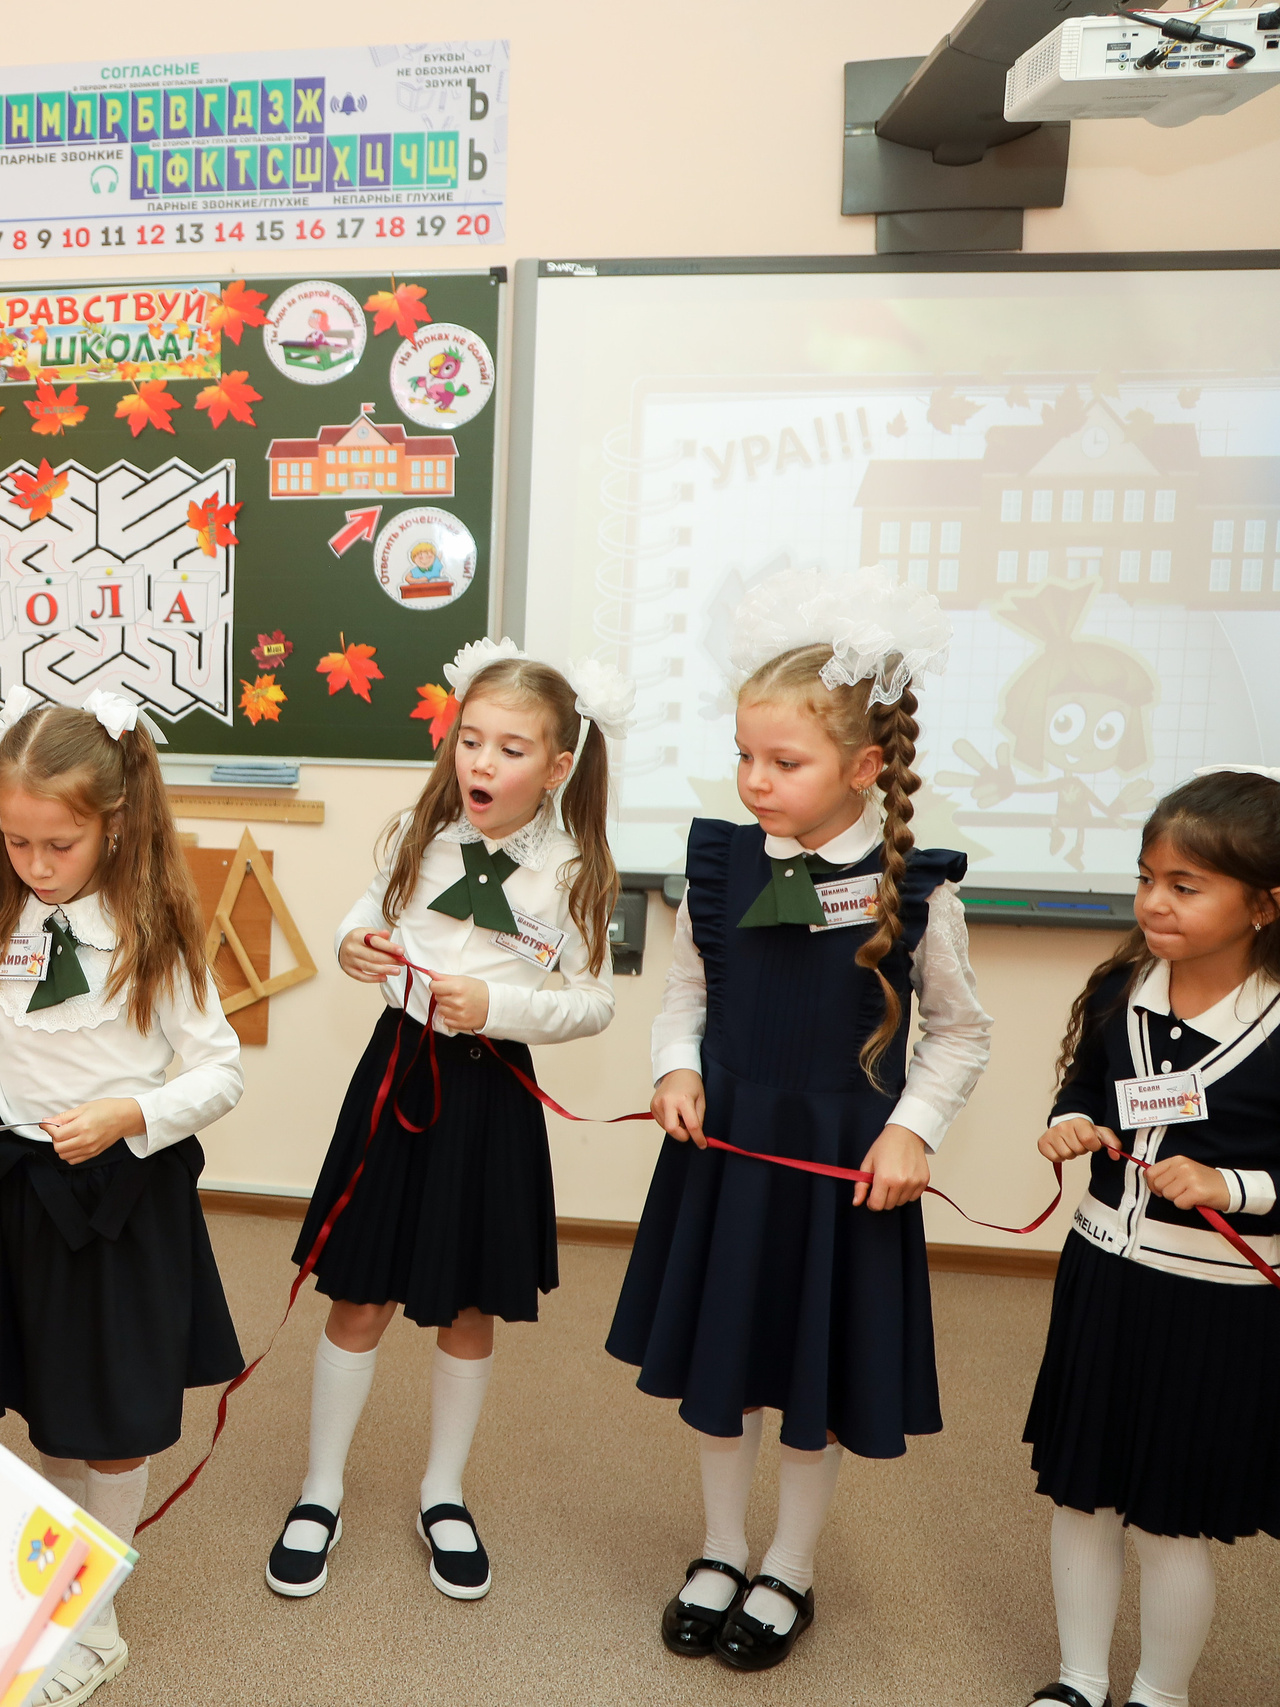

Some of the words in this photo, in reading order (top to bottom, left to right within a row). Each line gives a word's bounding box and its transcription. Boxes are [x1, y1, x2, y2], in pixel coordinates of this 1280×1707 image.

[424, 53, 465, 63] БУКВЫ
[101, 62, 200, 80] СОГЛАСНЫЕ
[397, 67, 411, 77] НЕ
[415, 64, 492, 76] ОБОЗНАЧАЮТ
[425, 79, 462, 88] ЗВУКИ
[61, 149, 124, 163] ЗВОНКИЕ
[468, 138, 488, 181] Ь
[147, 199, 198, 212] ПАРНЫЕ
[202, 196, 310, 211] ЗВОНКИЕ/ГЛУХИЕ
[333, 192, 403, 205] НЕПАРНЫЕ
[406, 191, 454, 203] ГЛУХИЕ
[12, 230, 28, 250] 8
[37, 228, 52, 249] 9
[62, 227, 90, 248] 10
[101, 226, 126, 247] 11
[137, 224, 165, 245] 12
[175, 223, 204, 244] 13
[214, 222, 244, 242] 14
[256, 220, 285, 241] 15
[295, 219, 326, 240] 16
[336, 218, 365, 238] 17
[375, 216, 405, 237] 18
[416, 215, 446, 236] 19
[456, 214, 491, 235] 20
[39, 330, 197, 368] ШКОЛА!
[399, 351, 412, 366] На
[453, 334, 467, 346] не
[467, 342, 490, 386] болтай!
[702, 406, 873, 486] УРА!!!
[380, 531, 400, 585] Ответить
[821, 887, 848, 897] Шилина
[822, 898, 868, 914] Арина
[505, 931, 543, 951] астя
[1138, 1084, 1161, 1094] Есаян
[1130, 1095, 1186, 1112] Рианна
